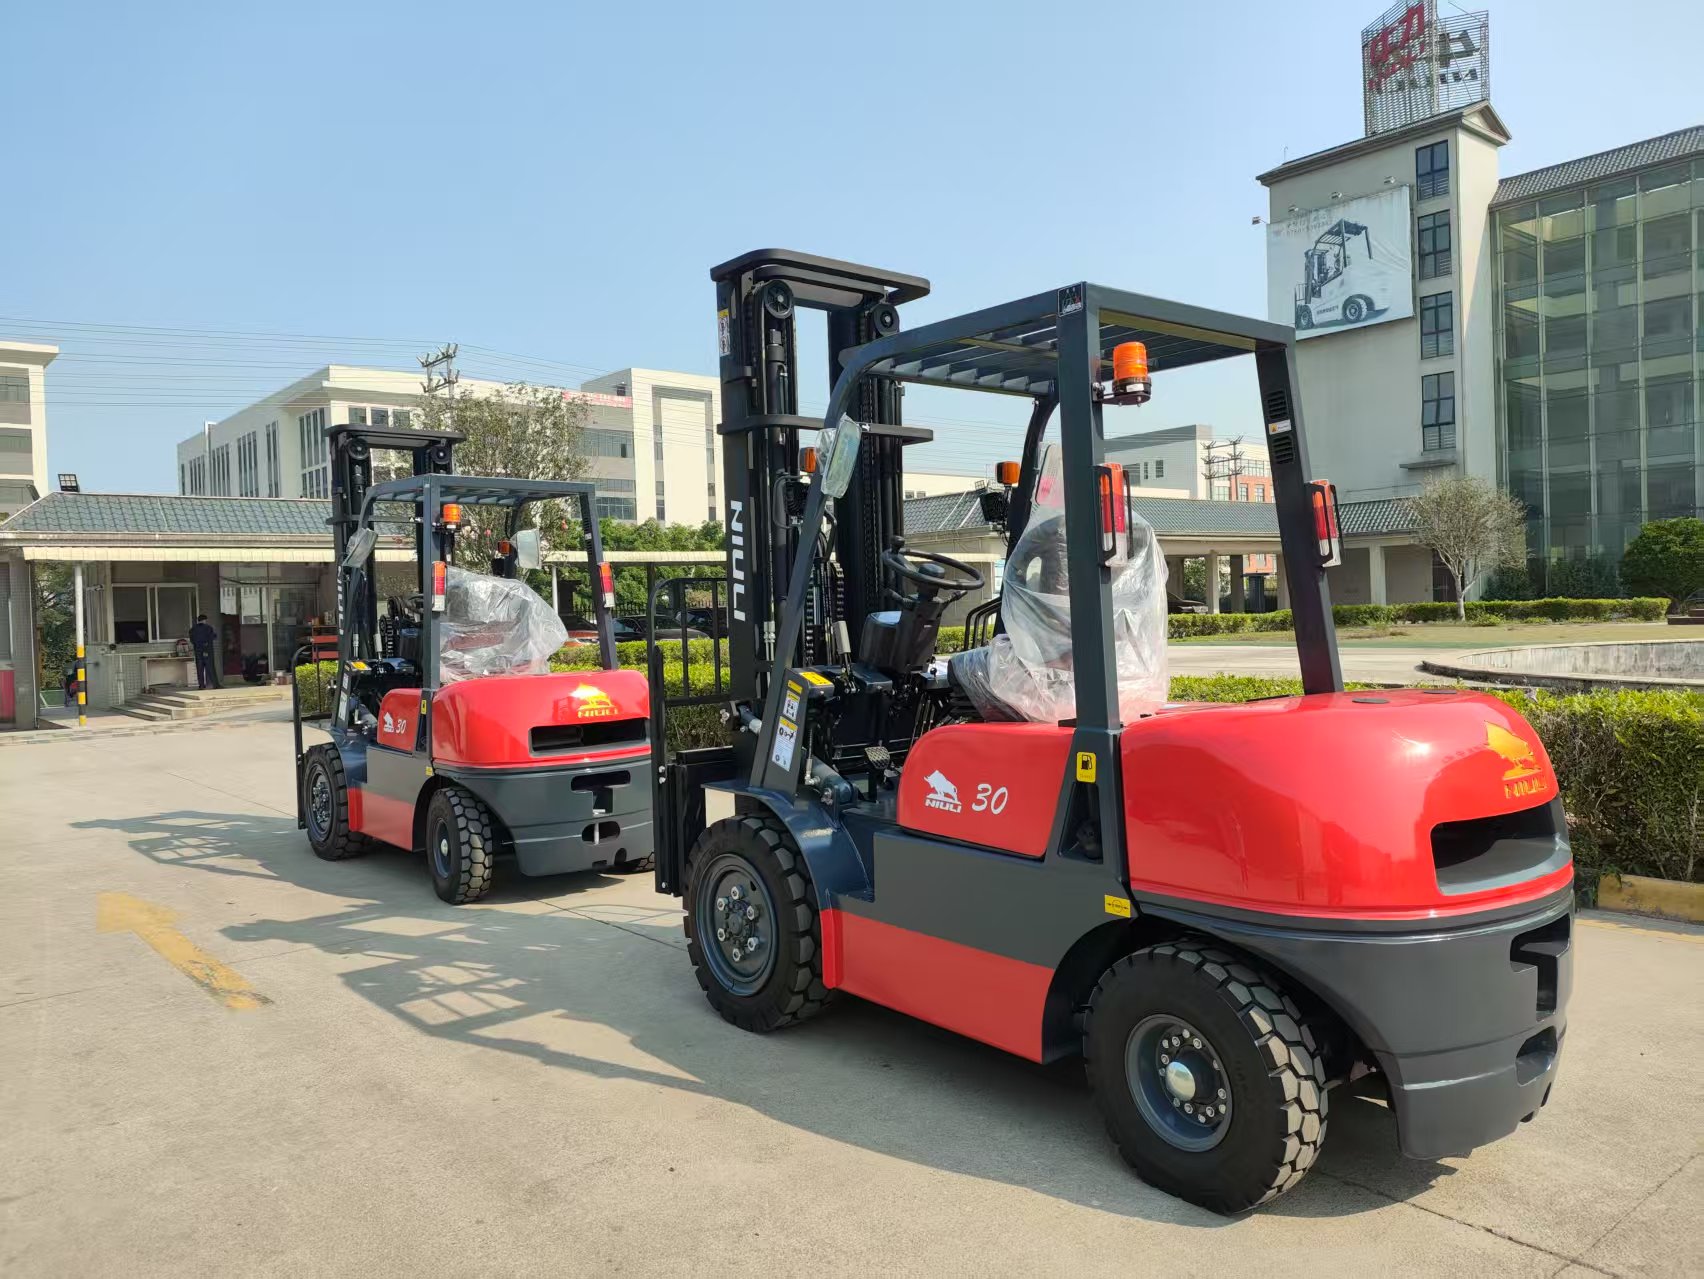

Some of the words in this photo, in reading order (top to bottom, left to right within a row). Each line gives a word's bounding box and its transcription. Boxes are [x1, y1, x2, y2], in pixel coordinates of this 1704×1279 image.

[730, 500, 745, 622] NIULI
[396, 719, 407, 734] 30
[925, 798, 962, 813] NIULI
[971, 783, 1008, 815] 30
